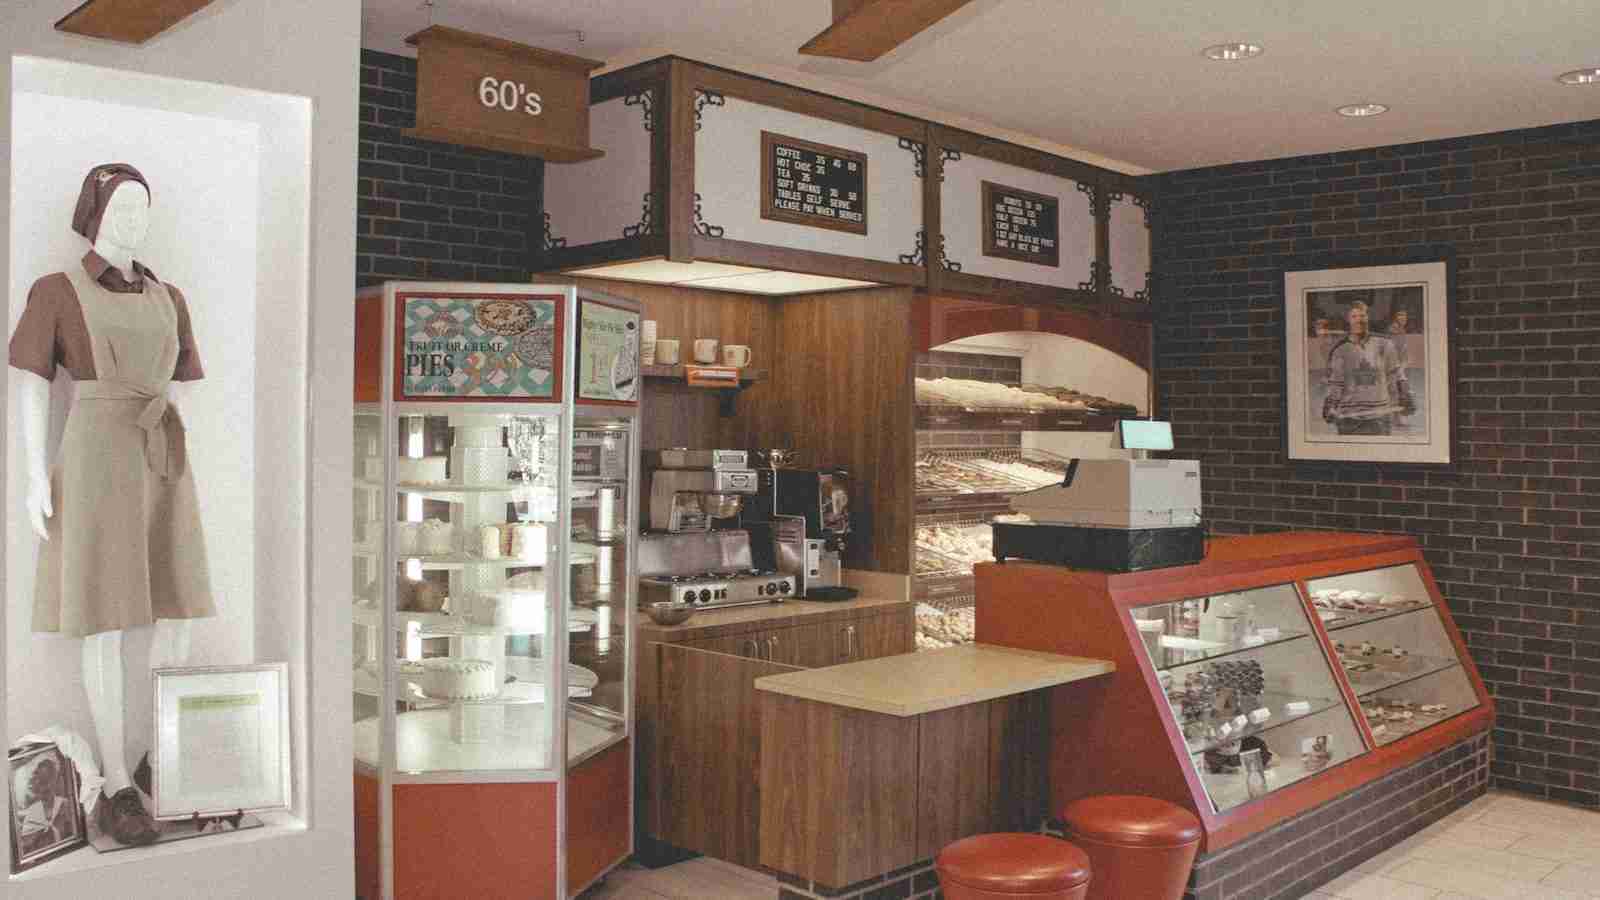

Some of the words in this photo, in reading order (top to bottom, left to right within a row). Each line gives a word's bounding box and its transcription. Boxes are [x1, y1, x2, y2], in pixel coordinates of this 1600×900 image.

[479, 76, 542, 116] 60's
[777, 147, 800, 159] COFFEE
[777, 157, 789, 168] HOT
[778, 168, 791, 178] TEA
[777, 178, 794, 189] SOFT
[775, 199, 800, 210] PLEASE
[807, 194, 823, 205] SELF
[408, 341, 442, 352] FRUIT
[446, 341, 463, 353] OR
[463, 342, 506, 353] CREME
[406, 353, 455, 377] PIES
